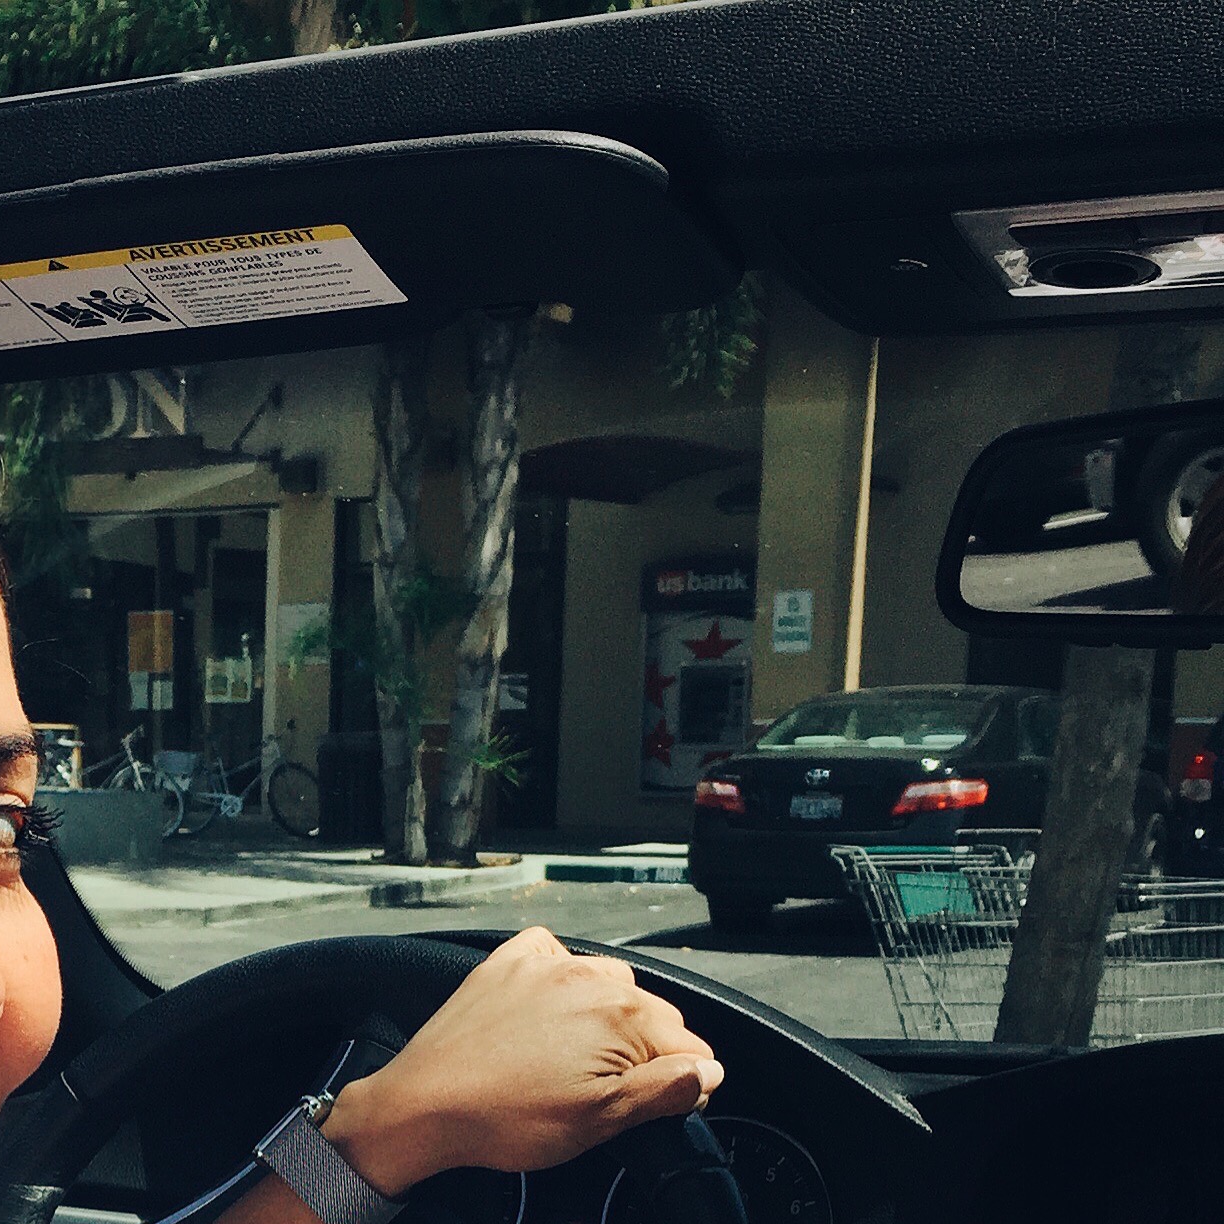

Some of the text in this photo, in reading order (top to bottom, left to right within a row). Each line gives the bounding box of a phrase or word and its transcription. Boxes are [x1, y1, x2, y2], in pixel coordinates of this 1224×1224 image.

[129, 228, 316, 262] AVERTISSEMENT
[140, 263, 192, 275] VALABLE
[194, 258, 226, 269] POUR
[230, 254, 261, 265] TOUS
[266, 250, 303, 261] TYPES
[305, 247, 323, 256] DE
[147, 270, 206, 283] COUSSINS
[209, 261, 284, 276] GONFLABLES
[765, 1167, 776, 1183] 5
[790, 1201, 801, 1215] 6
